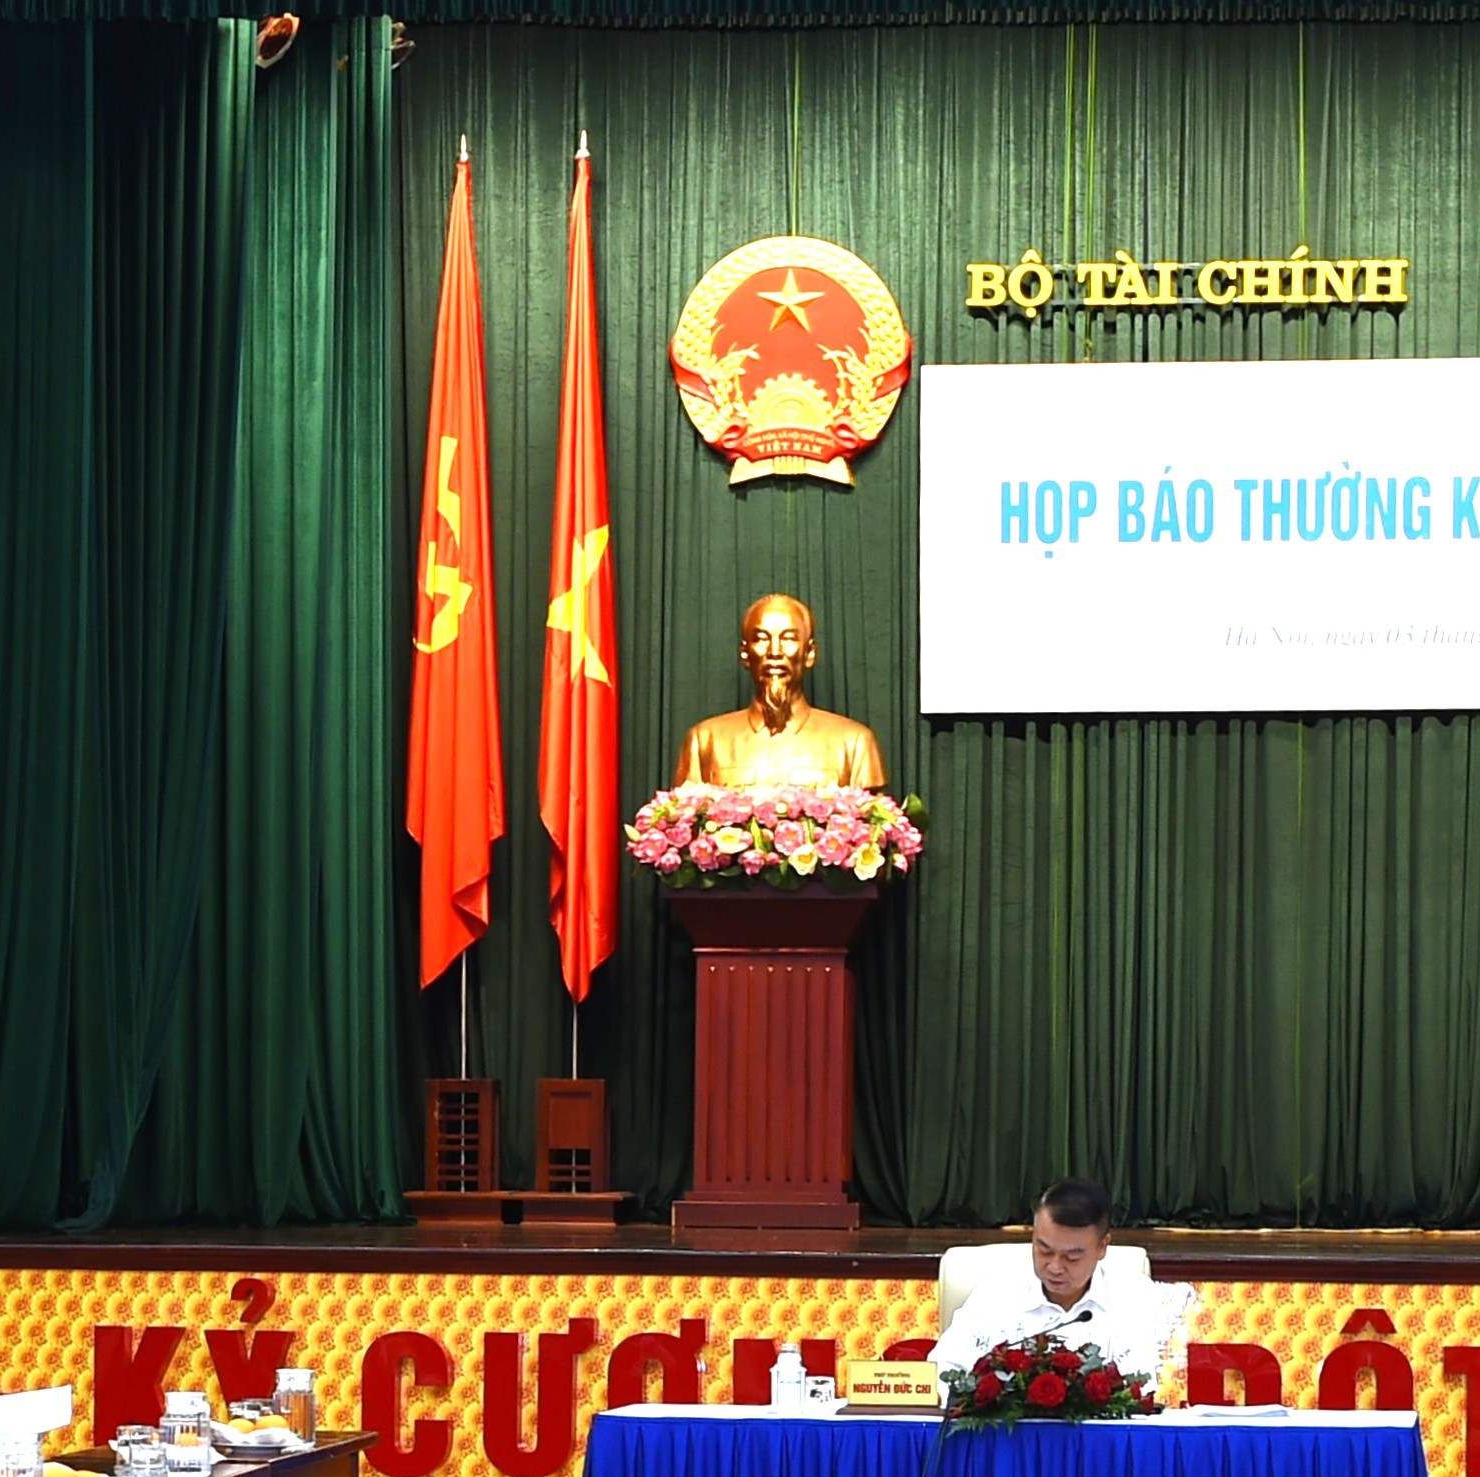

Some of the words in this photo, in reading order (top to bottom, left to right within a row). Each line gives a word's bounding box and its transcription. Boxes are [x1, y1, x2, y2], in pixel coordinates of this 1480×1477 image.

[966, 249, 1053, 318] BỘ
[1077, 250, 1178, 306] TÀI
[1198, 245, 1409, 305] CHÍNH
[793, 442, 822, 454] NAM
[1000, 479, 1098, 559] HỌP
[1118, 465, 1215, 543] BÁO
[1233, 461, 1432, 542] THƯỜNG
[93, 1277, 296, 1448] KỶ
[915, 1384, 932, 1394] CHI
